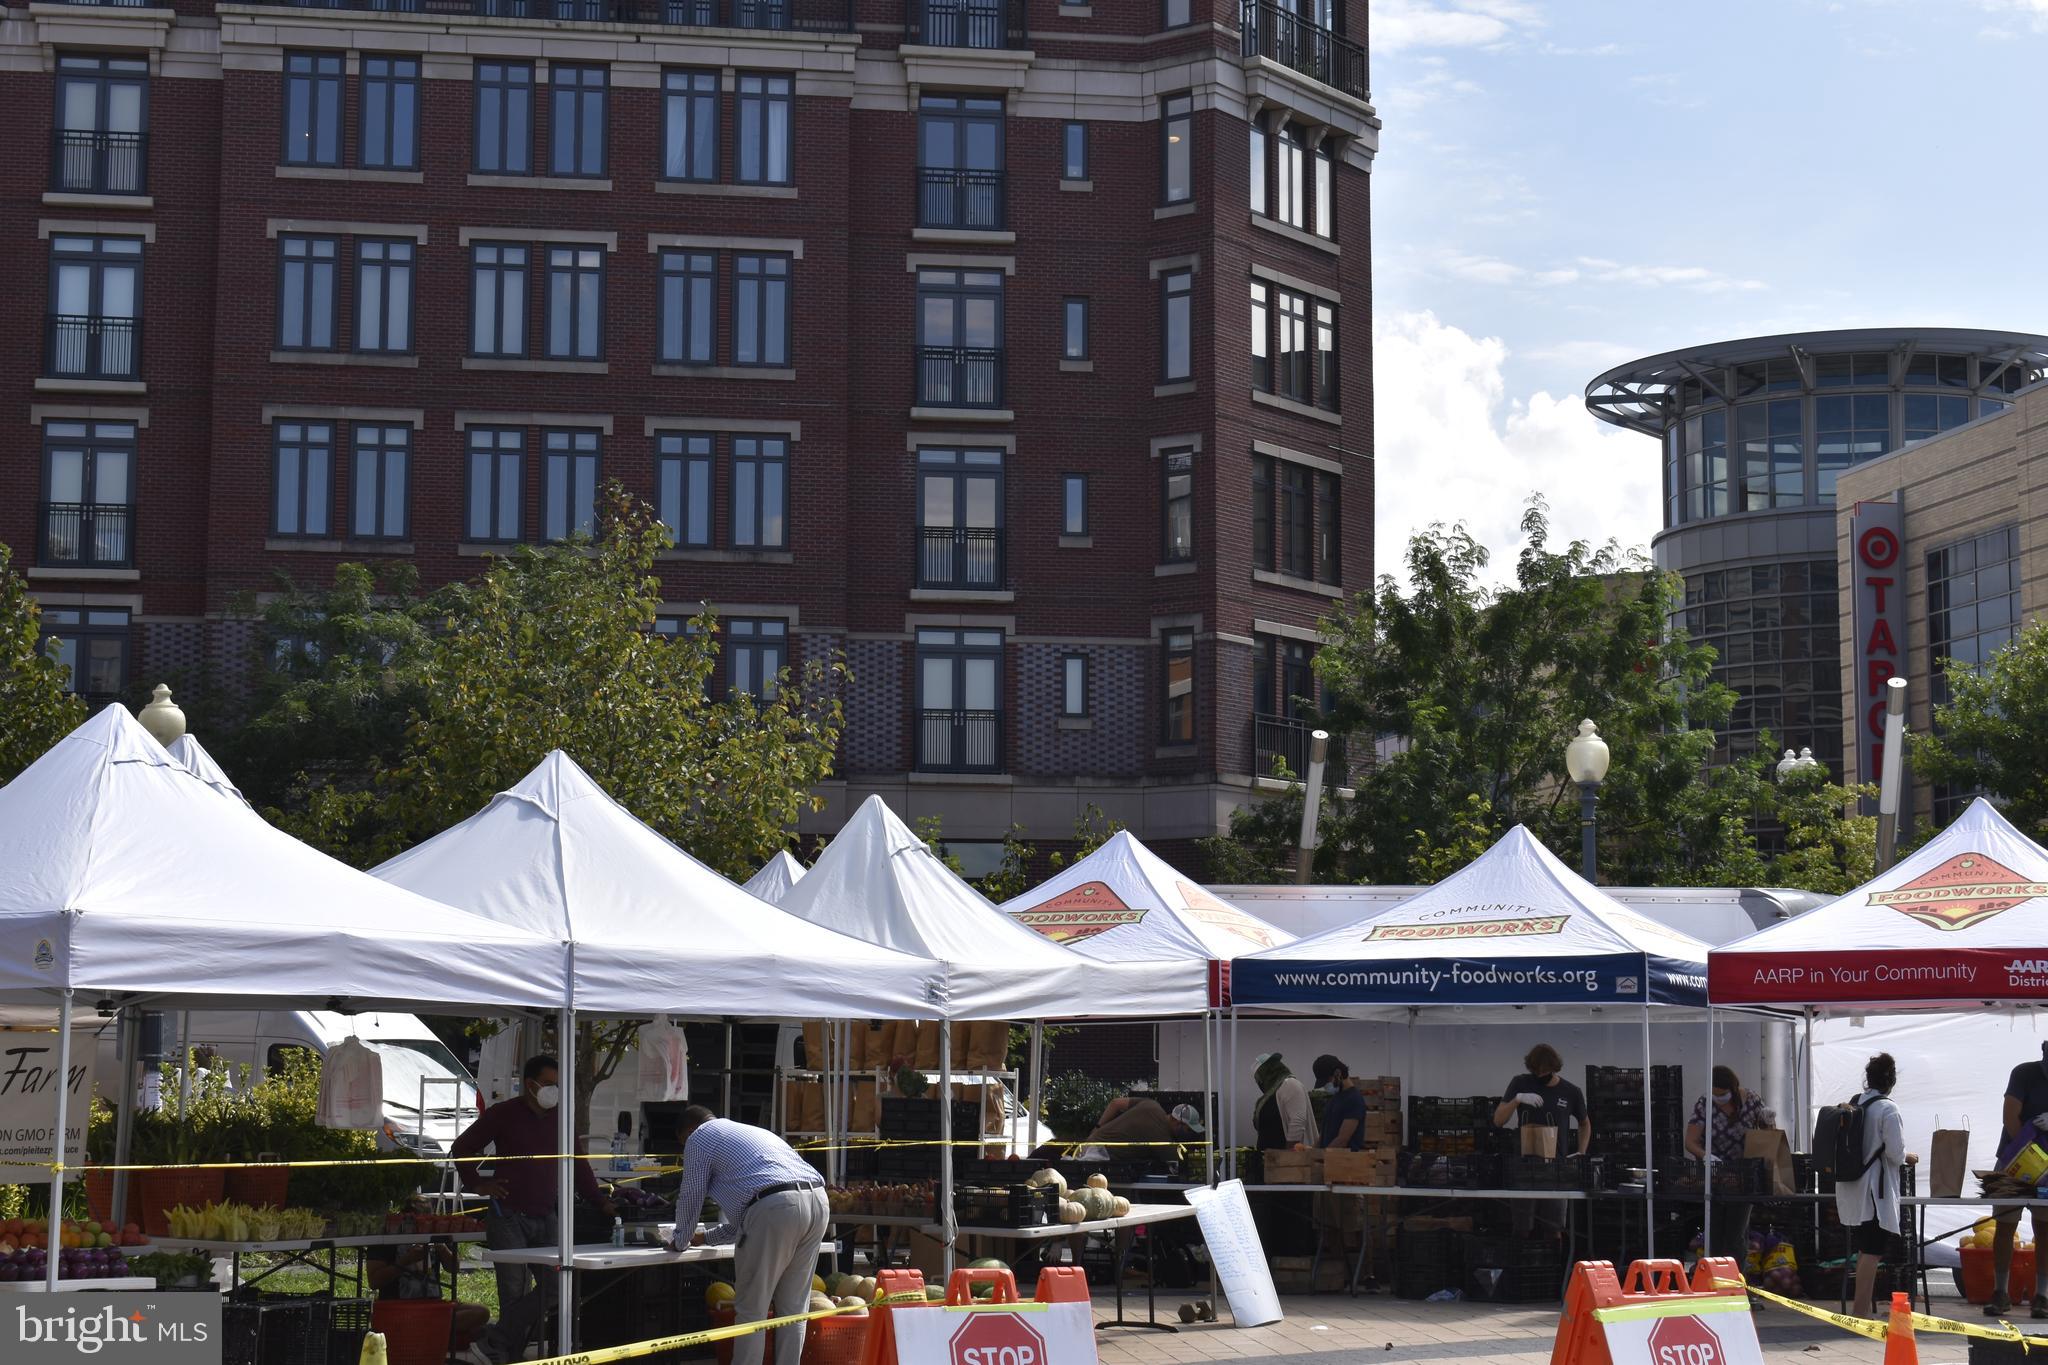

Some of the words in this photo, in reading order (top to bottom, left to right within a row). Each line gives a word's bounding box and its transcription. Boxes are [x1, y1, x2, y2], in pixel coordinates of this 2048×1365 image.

[1878, 884, 2048, 903] FOODWORKS
[1418, 903, 1537, 921] COMMUNITY
[1379, 918, 1556, 939] FOODWORKS
[1274, 963, 1599, 992] www.community-foodworks.org
[1754, 967, 1805, 984] AARP
[1810, 967, 1825, 983] in
[1829, 967, 1870, 983] Your
[1875, 962, 1978, 983] Community
[15, 1128, 46, 1141] GMO
[48, 1127, 81, 1141] FRM
[963, 1345, 1034, 1365] STOP
[1660, 1343, 1714, 1365] STOP
